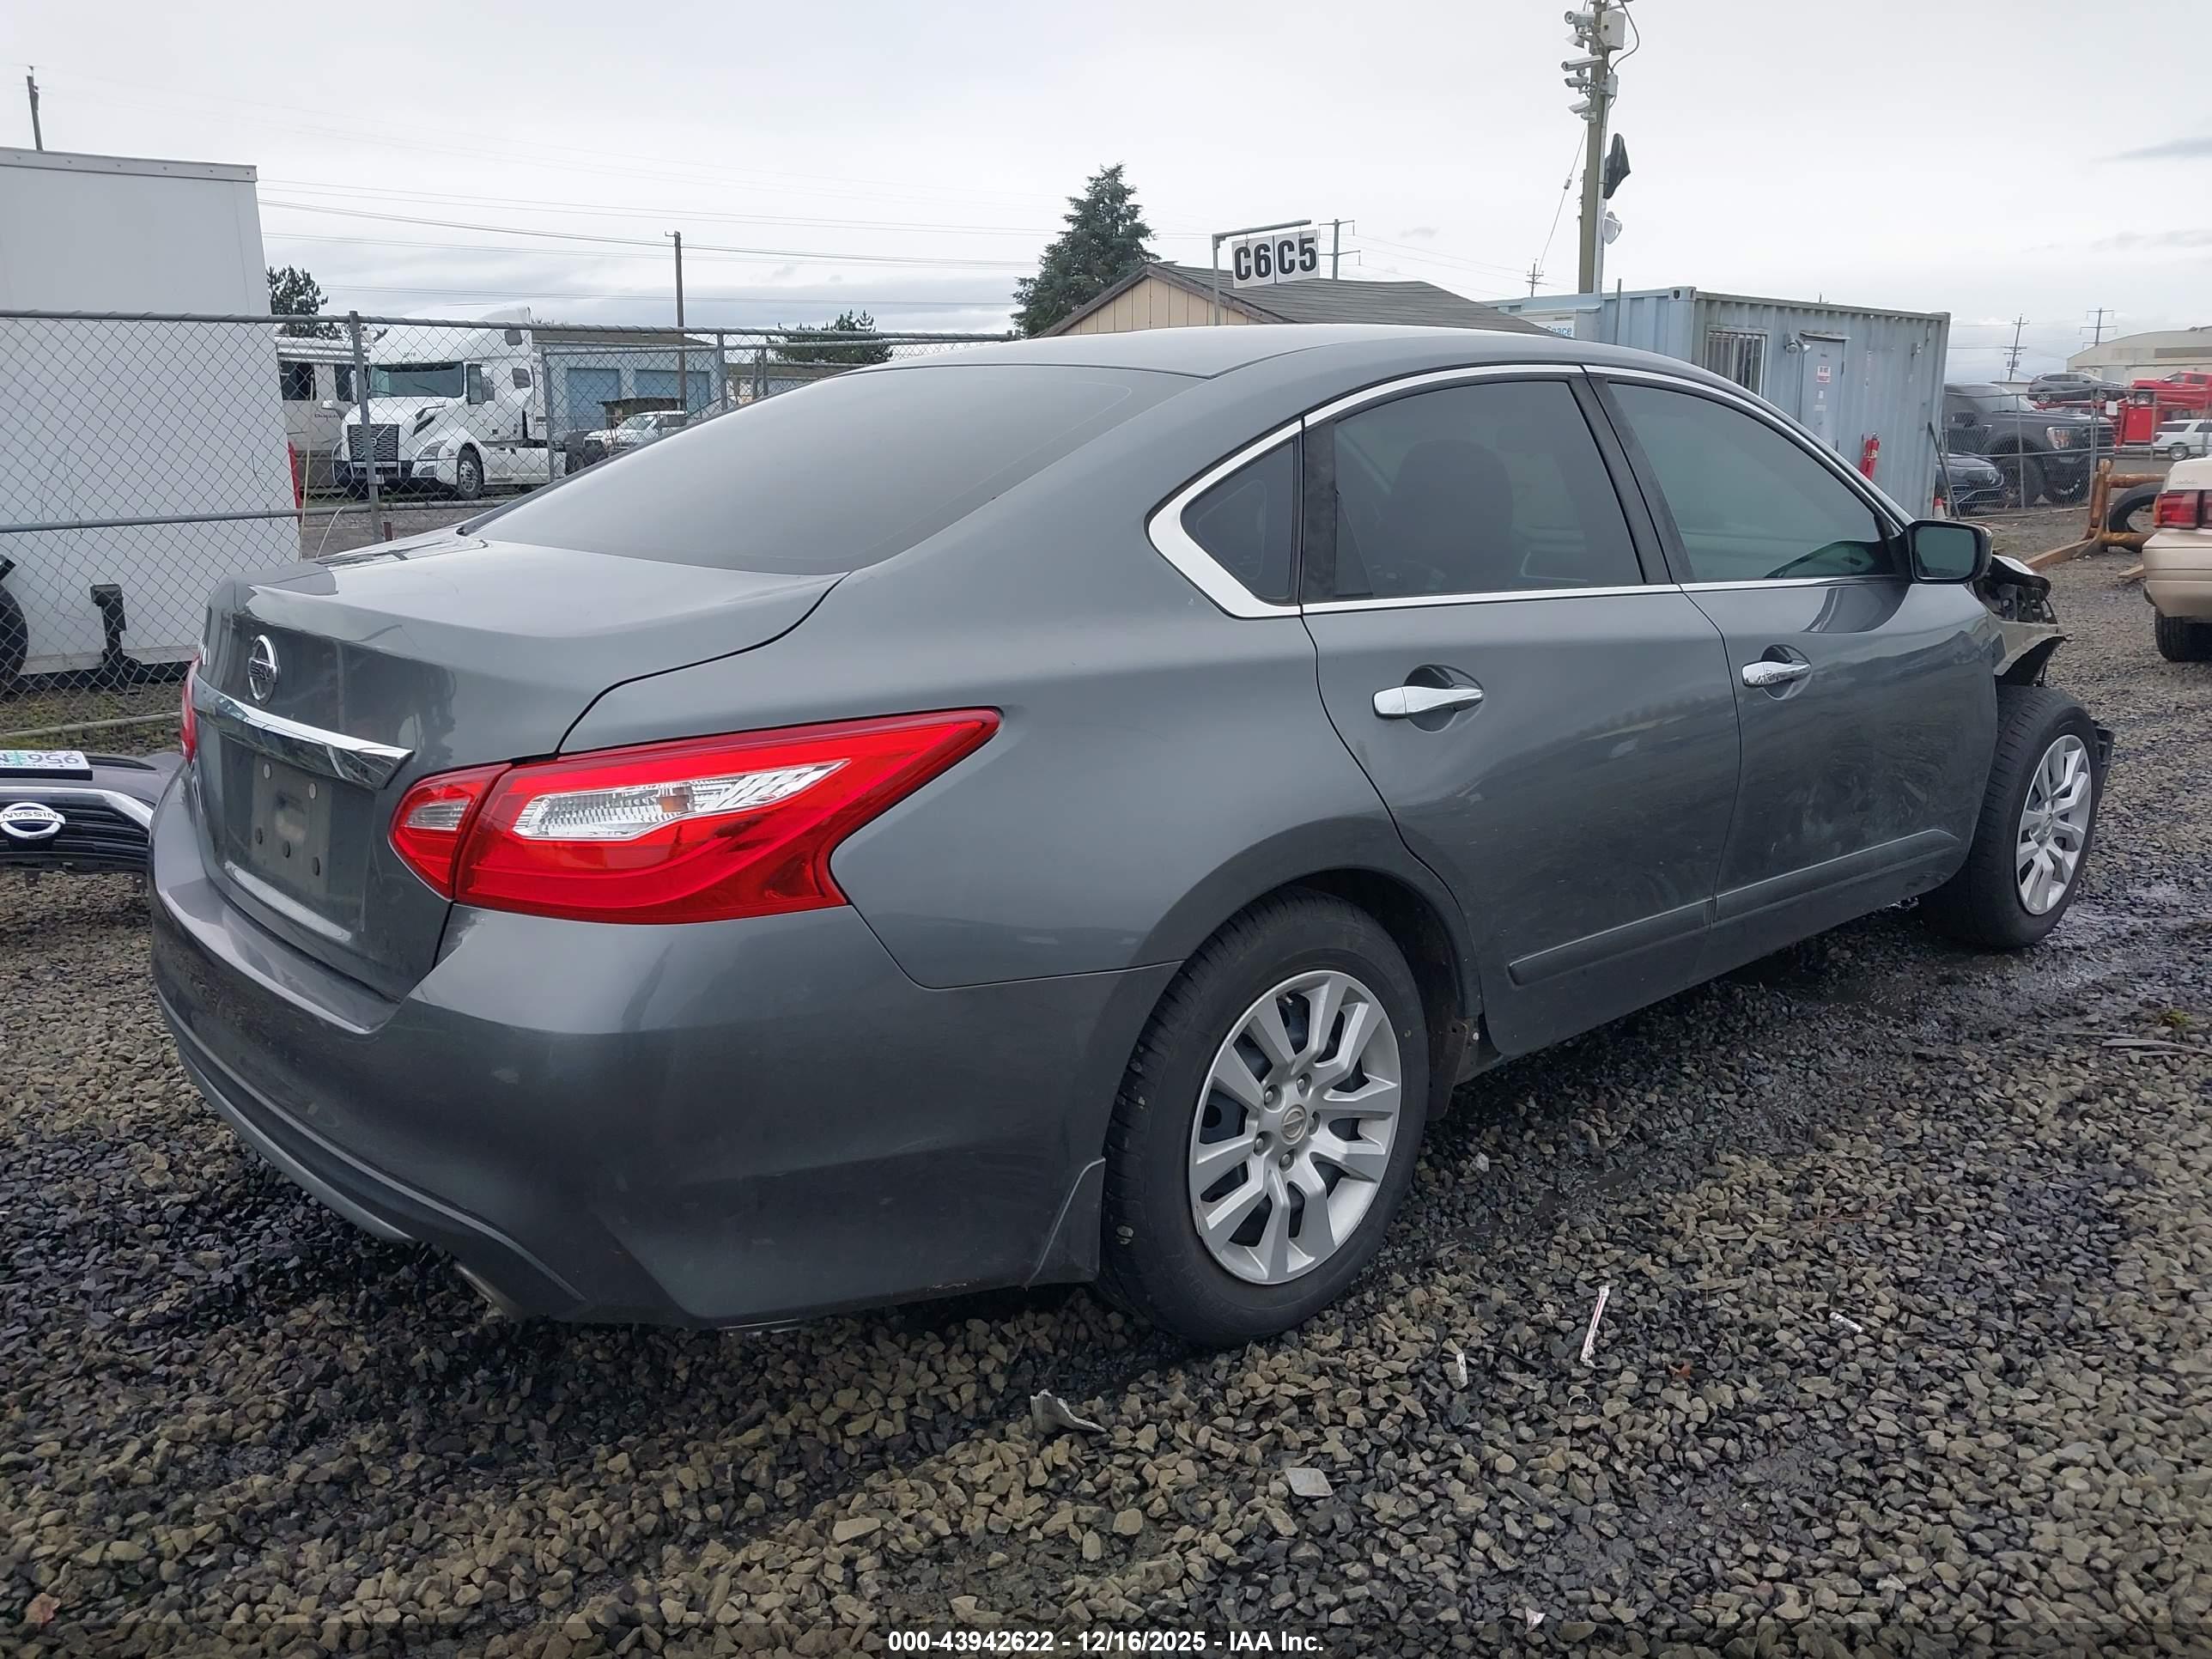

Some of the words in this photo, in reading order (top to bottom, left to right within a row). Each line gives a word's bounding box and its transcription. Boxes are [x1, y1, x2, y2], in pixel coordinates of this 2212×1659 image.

[1234, 243, 1272, 281] C6
[1277, 237, 1316, 275] C5
[2, 811, 58, 820] NISSAN
